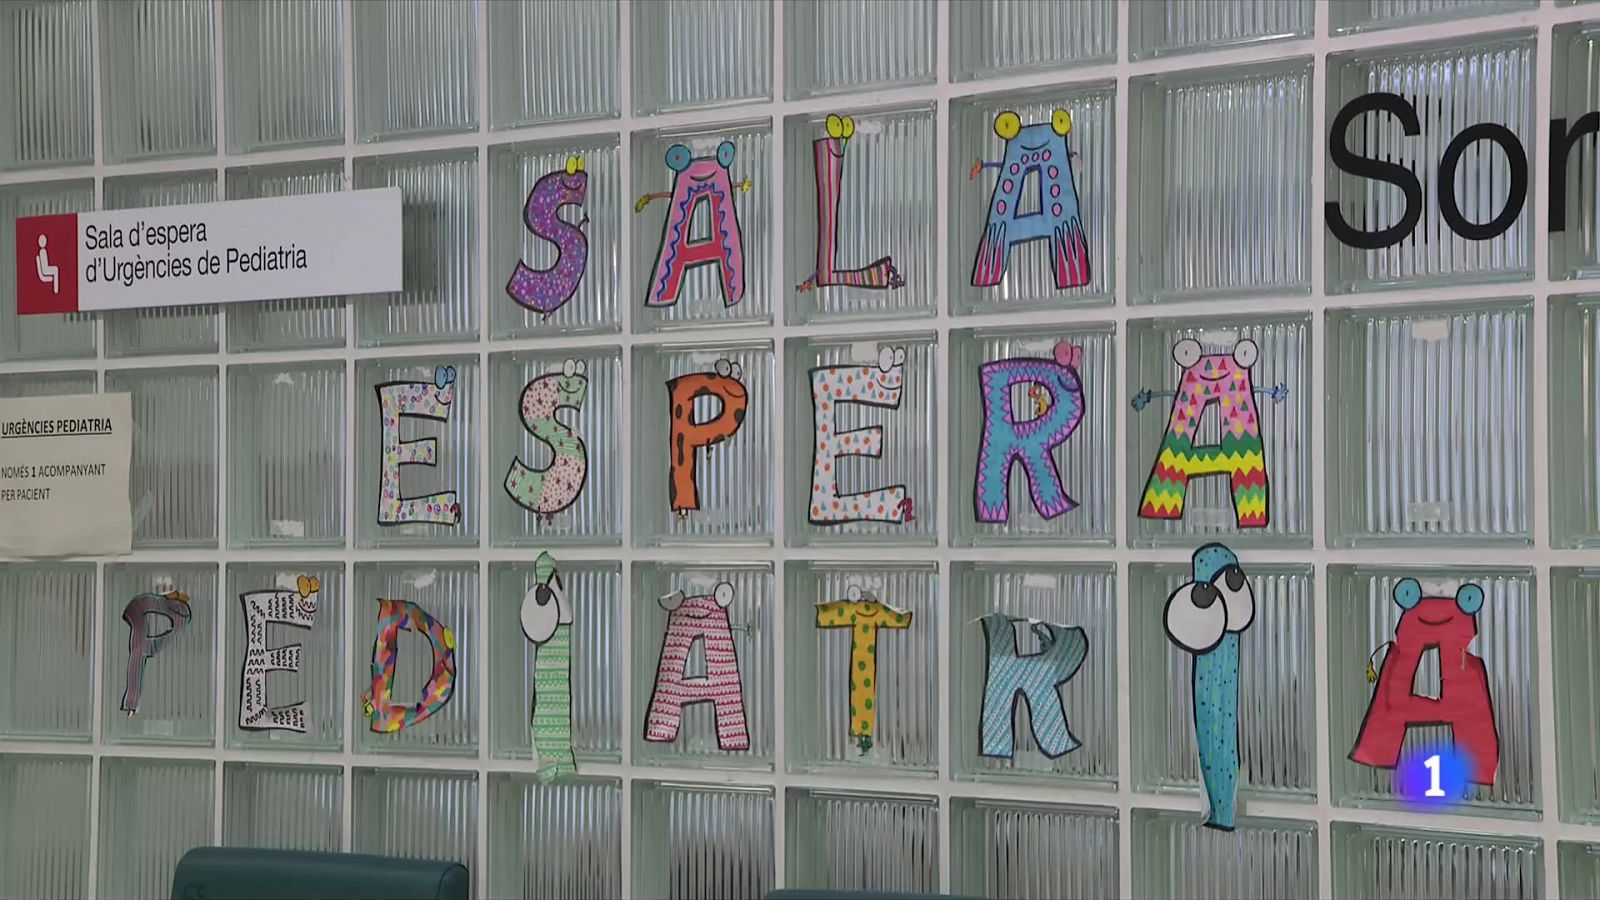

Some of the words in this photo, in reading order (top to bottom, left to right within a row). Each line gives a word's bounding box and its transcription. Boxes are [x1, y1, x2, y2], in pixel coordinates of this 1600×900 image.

[506, 109, 1091, 314] SALA
[85, 223, 124, 250] Sala
[128, 221, 208, 251] d'espera
[85, 252, 193, 287] d'Urgències
[197, 249, 221, 276] de
[226, 243, 308, 274] Pediatria
[1, 418, 54, 436] URGÈNCIES
[56, 417, 112, 433] PEDIATRIA
[374, 338, 1269, 528] ESPERA
[1, 464, 29, 479] NOMÉS
[31, 467, 36, 477] 1
[39, 464, 106, 477] ACOMPANYANT
[1, 488, 16, 501] PER
[16, 487, 51, 501] PACIENT
